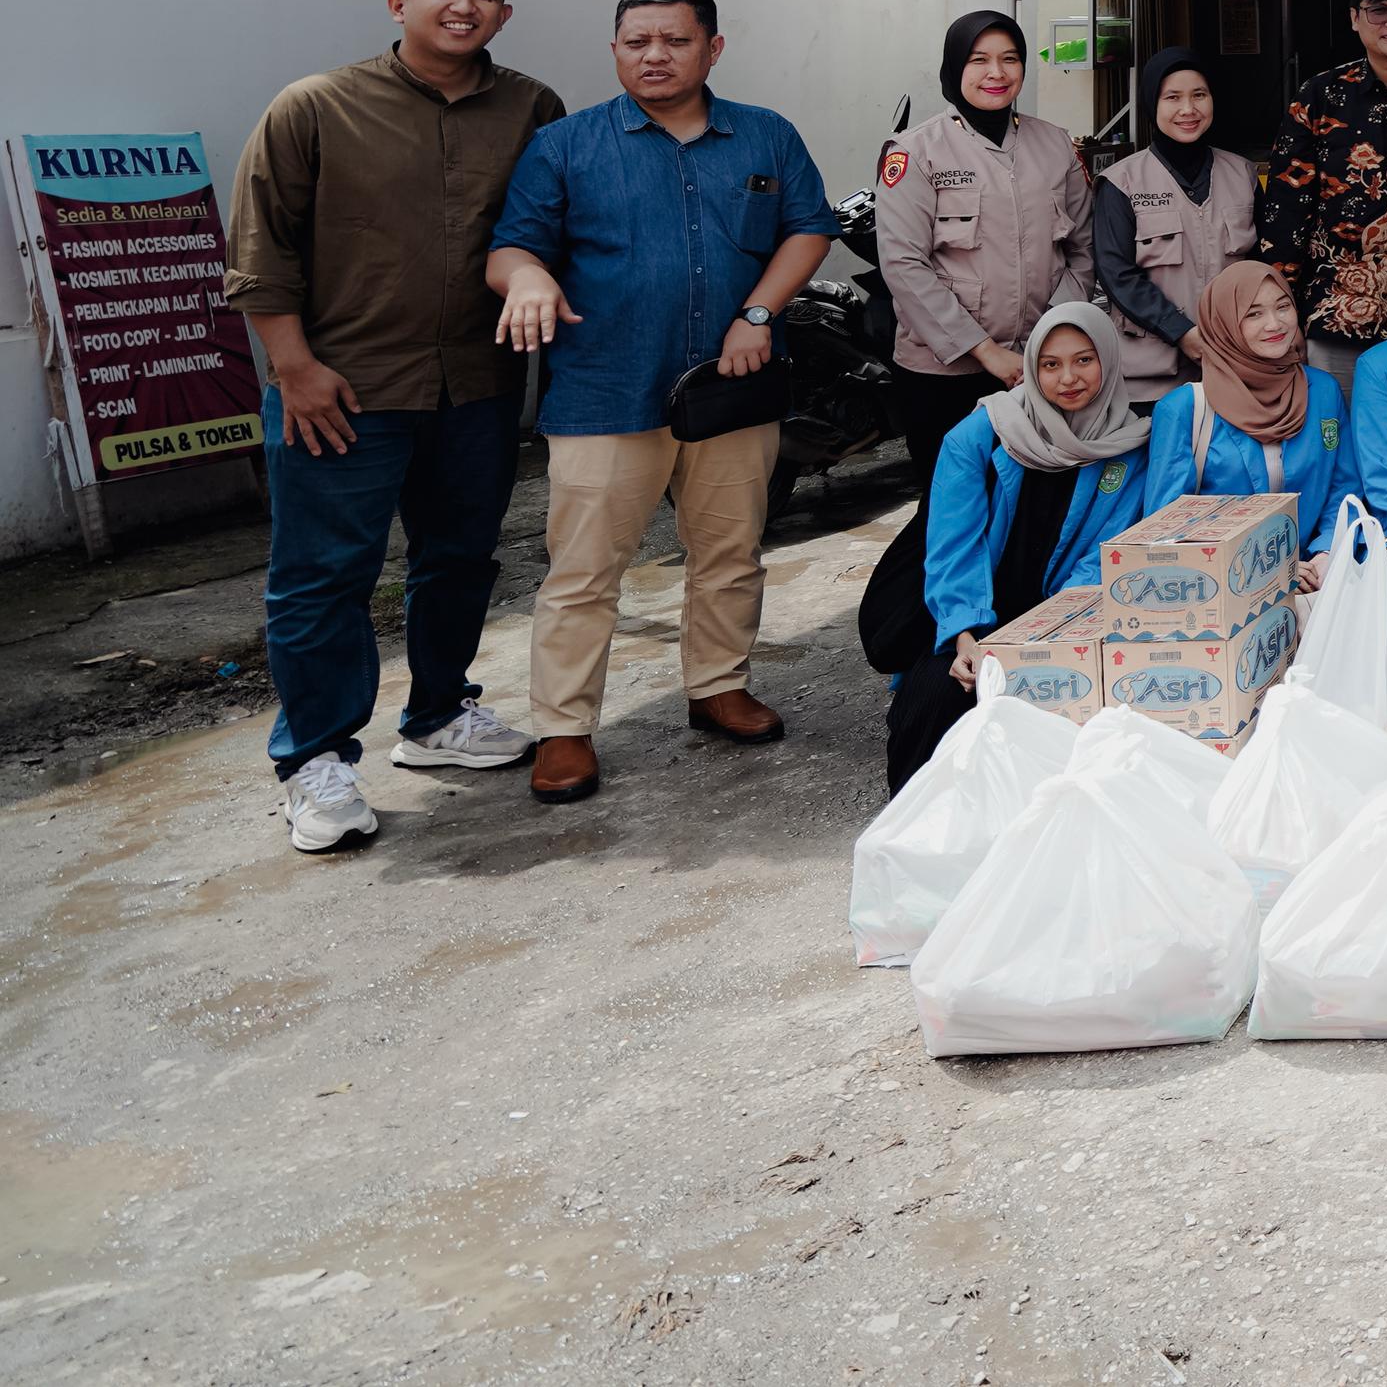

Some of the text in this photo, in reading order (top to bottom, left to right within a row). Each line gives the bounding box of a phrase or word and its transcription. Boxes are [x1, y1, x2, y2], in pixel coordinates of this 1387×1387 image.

[36, 146, 202, 178] KURNIA
[934, 177, 973, 188] POLRI
[57, 202, 208, 224] Sedia & Melayani
[1132, 199, 1170, 208] POLRI
[62, 233, 217, 260] FASHION ACCESSORIES
[69, 261, 224, 290] KOSMETIK KECANTIKAN
[75, 299, 170, 322] PERLENGKAPAN
[173, 294, 199, 312] ALAT
[84, 331, 122, 352] FOTO
[124, 328, 161, 349] COPY
[174, 323, 206, 343] JILID
[90, 363, 131, 385] PRINT
[143, 352, 224, 378] LAMINATING
[97, 397, 137, 419] SCAN
[115, 422, 254, 463] PULSA & TOKEN
[1246, 518, 1293, 588] Asri
[1135, 576, 1207, 603] Asri
[1251, 612, 1290, 684] Asri
[1012, 674, 1080, 702] Asri
[1137, 674, 1210, 703] Asri
